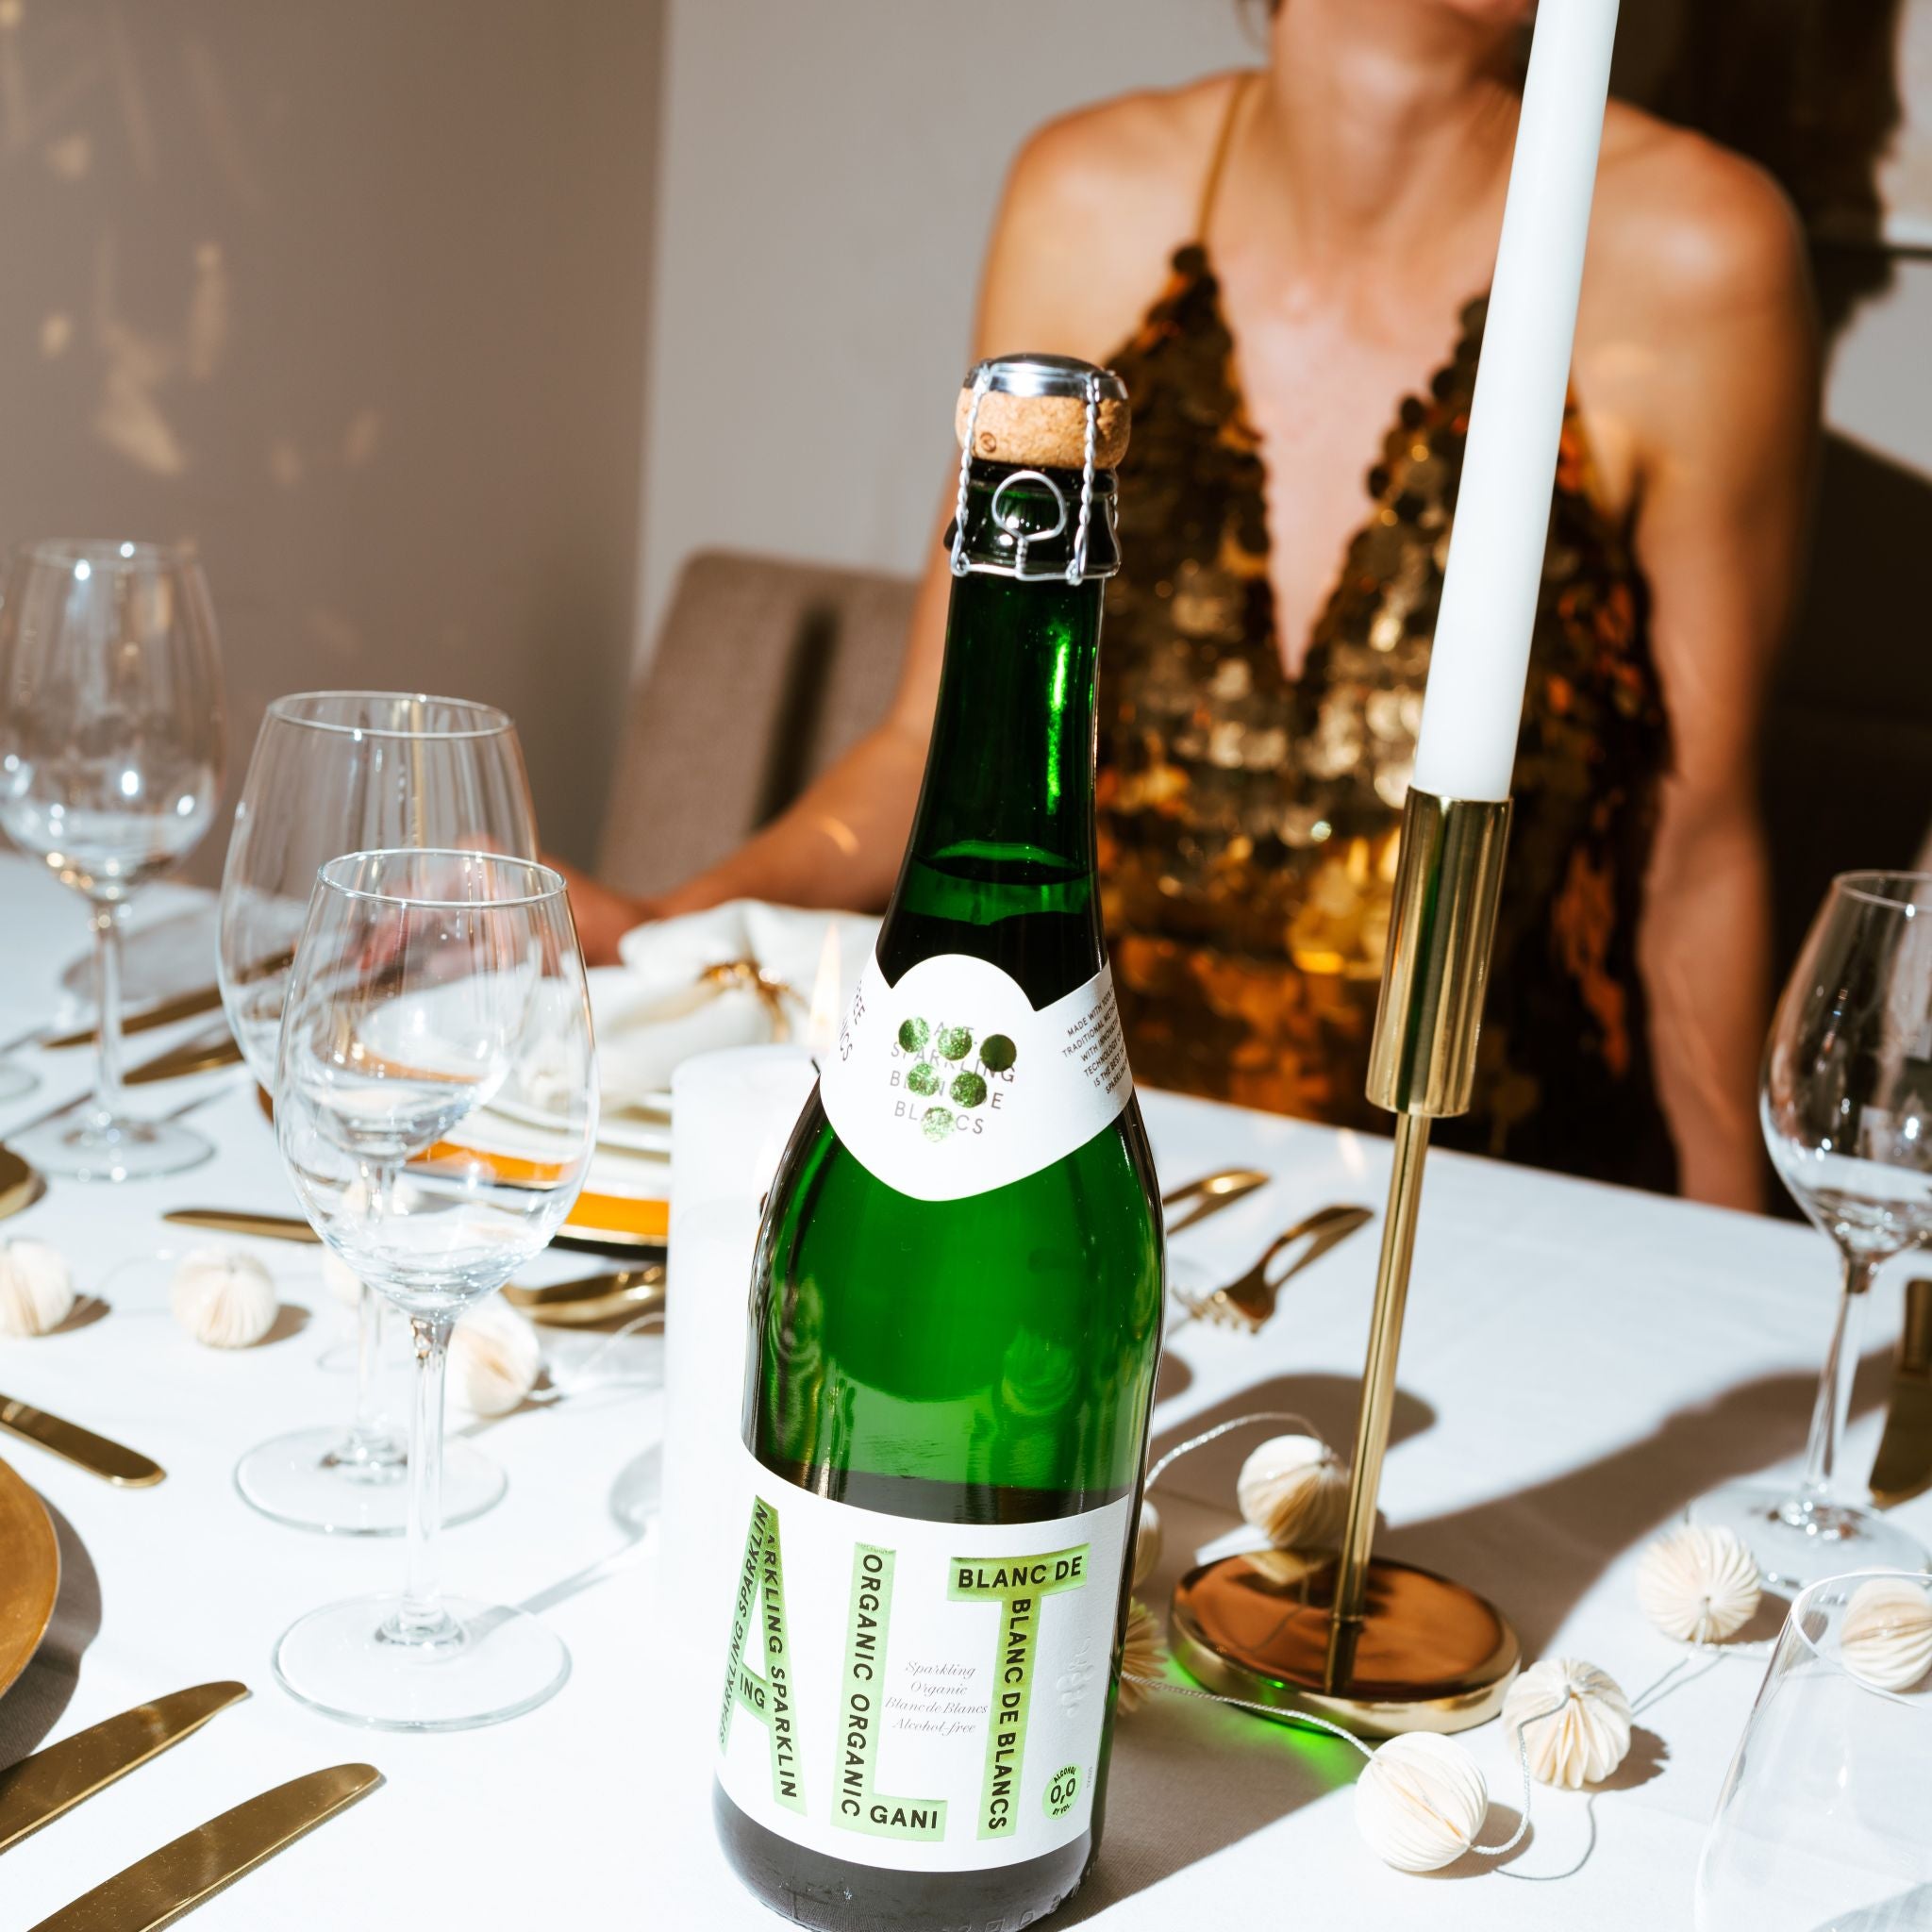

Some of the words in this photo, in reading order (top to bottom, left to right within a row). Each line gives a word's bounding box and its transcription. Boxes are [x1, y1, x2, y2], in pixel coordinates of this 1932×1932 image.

[1067, 1018, 1088, 1036] MADE
[1088, 1003, 1103, 1020] WITH
[1061, 1019, 1104, 1058] TRADITIONAL
[1080, 1043, 1098, 1062] WITH
[1083, 1038, 1117, 1077] TECHNOLOGY
[1093, 1078, 1101, 1088] IS
[1100, 1067, 1111, 1083] THE
[894, 1100, 984, 1135] BLCS
[958, 1564, 1047, 1589] BLANC
[1055, 1556, 1083, 1581] DE
[719, 1621, 743, 1743] SPARKLING
[739, 1504, 768, 1618] SPARKLIN
[853, 1554, 883, 1681] ORGANIC
[1004, 1598, 1032, 1684] BLANC
[905, 1660, 976, 1679] Sparkling
[740, 1673, 766, 1709] ING
[885, 1696, 924, 1712] Blanc
[925, 1701, 941, 1713] de
[942, 1702, 989, 1714] Blancs
[909, 1680, 968, 1697] Organic
[999, 1691, 1022, 1724] DE
[771, 1665, 797, 1797] SPARKLIN
[841, 1693, 870, 1817] ORGANIC
[988, 1732, 1017, 1830] BLANCS
[1050, 1777, 1076, 1804] 0,0
[870, 1805, 938, 1829] GANI
